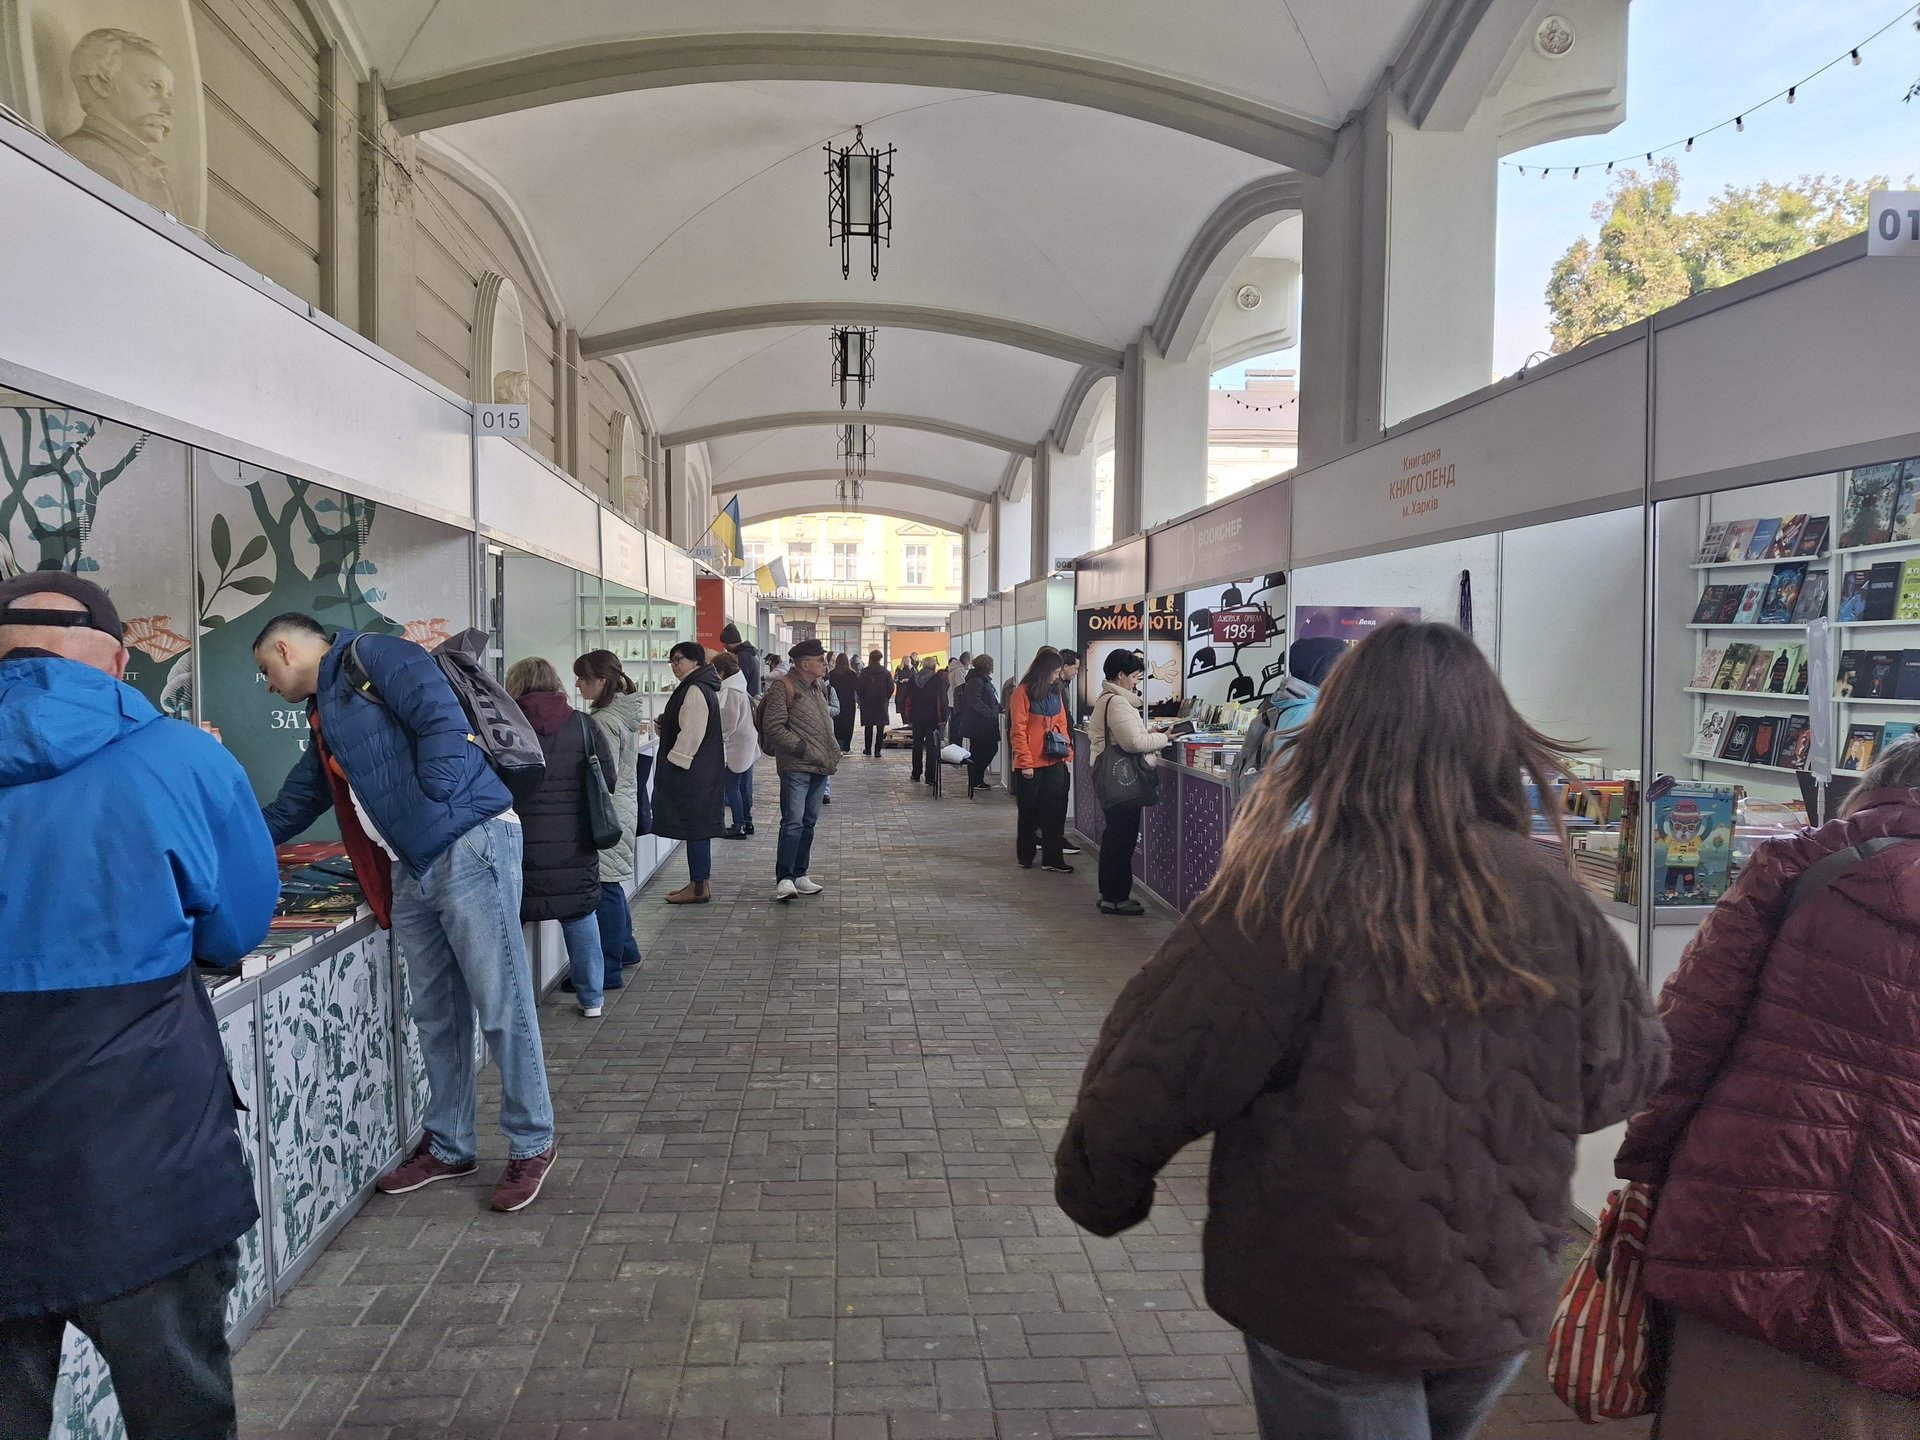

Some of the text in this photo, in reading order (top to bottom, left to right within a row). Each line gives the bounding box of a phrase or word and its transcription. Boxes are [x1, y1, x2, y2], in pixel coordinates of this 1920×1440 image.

[1879, 208, 1920, 241] 01
[482, 411, 520, 429] 015
[1403, 448, 1441, 471] Книгарня
[1389, 463, 1456, 500] КНИГОЛЕНД
[1402, 496, 1439, 517] м. Харків
[1198, 517, 1242, 547] BOOKCHEF
[696, 548, 712, 557] 016
[1056, 561, 1072, 569] 008
[1217, 614, 1240, 622] ДЖОРДЖ
[1223, 624, 1256, 639] 1984
